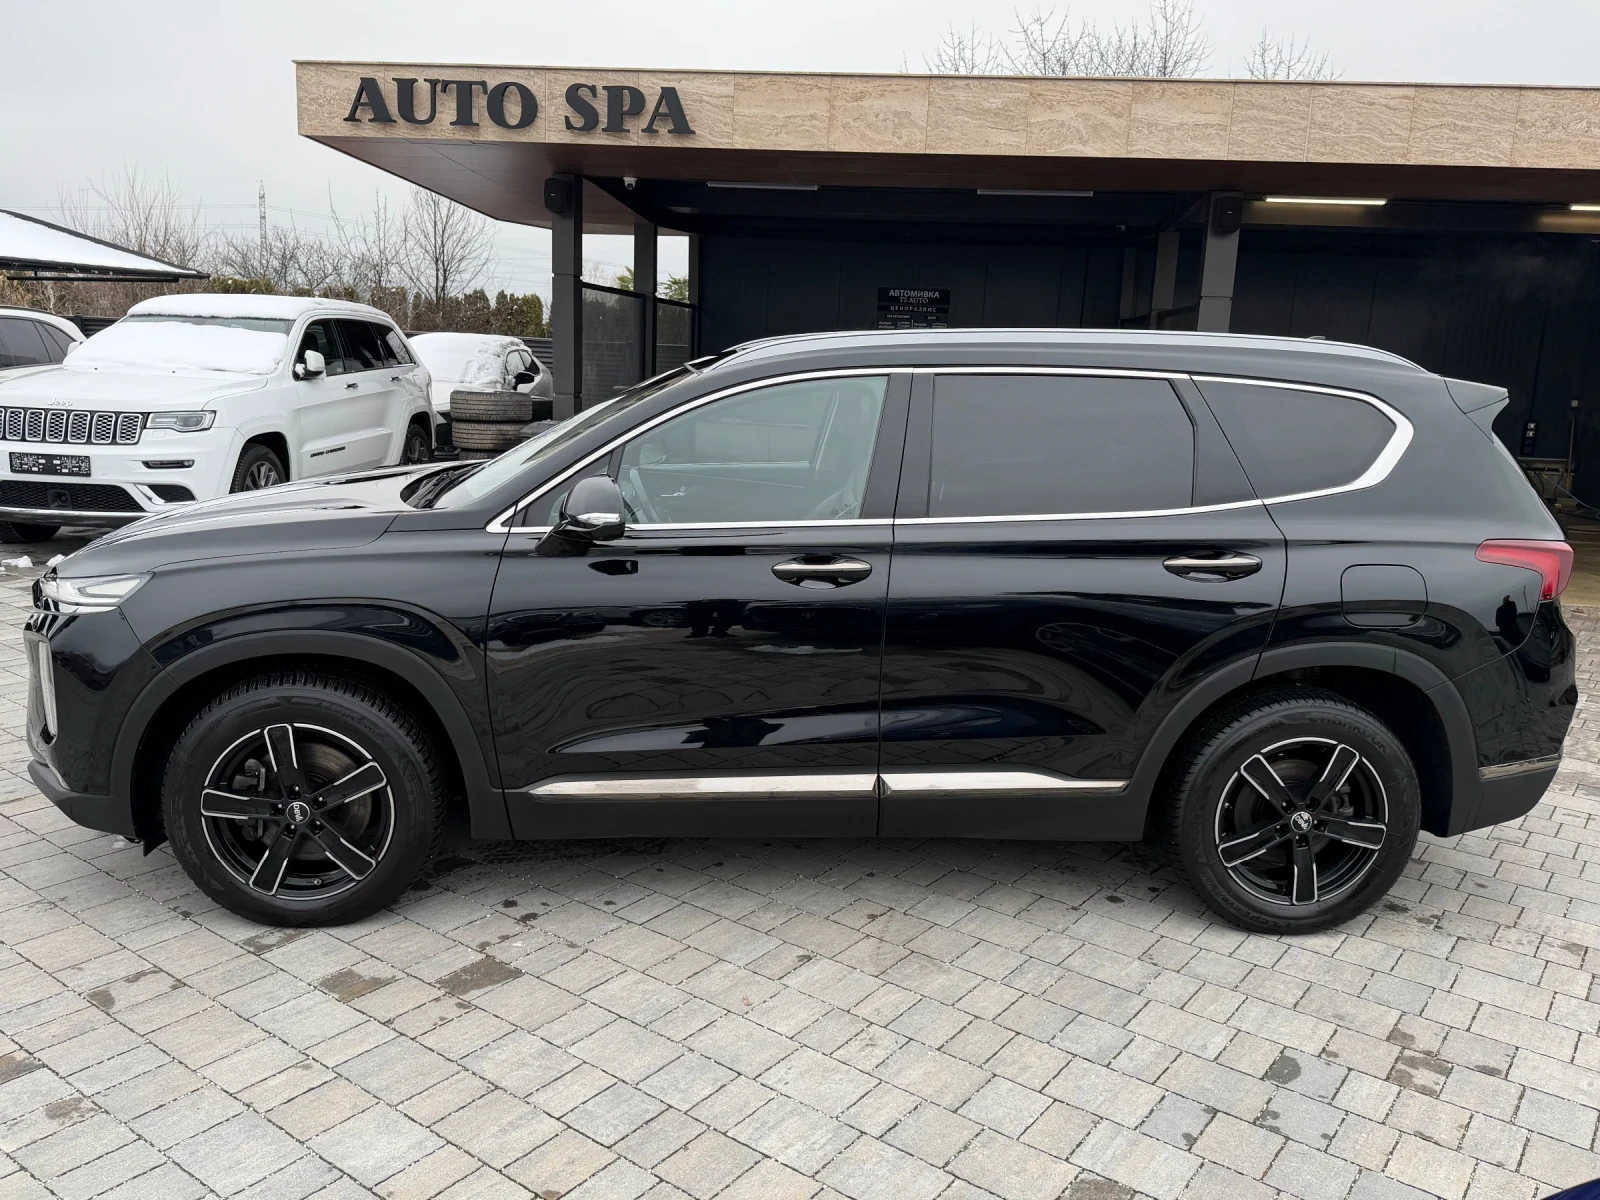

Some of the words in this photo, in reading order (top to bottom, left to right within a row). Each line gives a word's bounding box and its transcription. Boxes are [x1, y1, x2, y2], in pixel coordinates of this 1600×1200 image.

[343, 77, 538, 129] AUTO
[565, 82, 696, 134] SPA
[888, 289, 940, 298] АВТОМИВКА
[48, 398, 73, 408] Jeep
